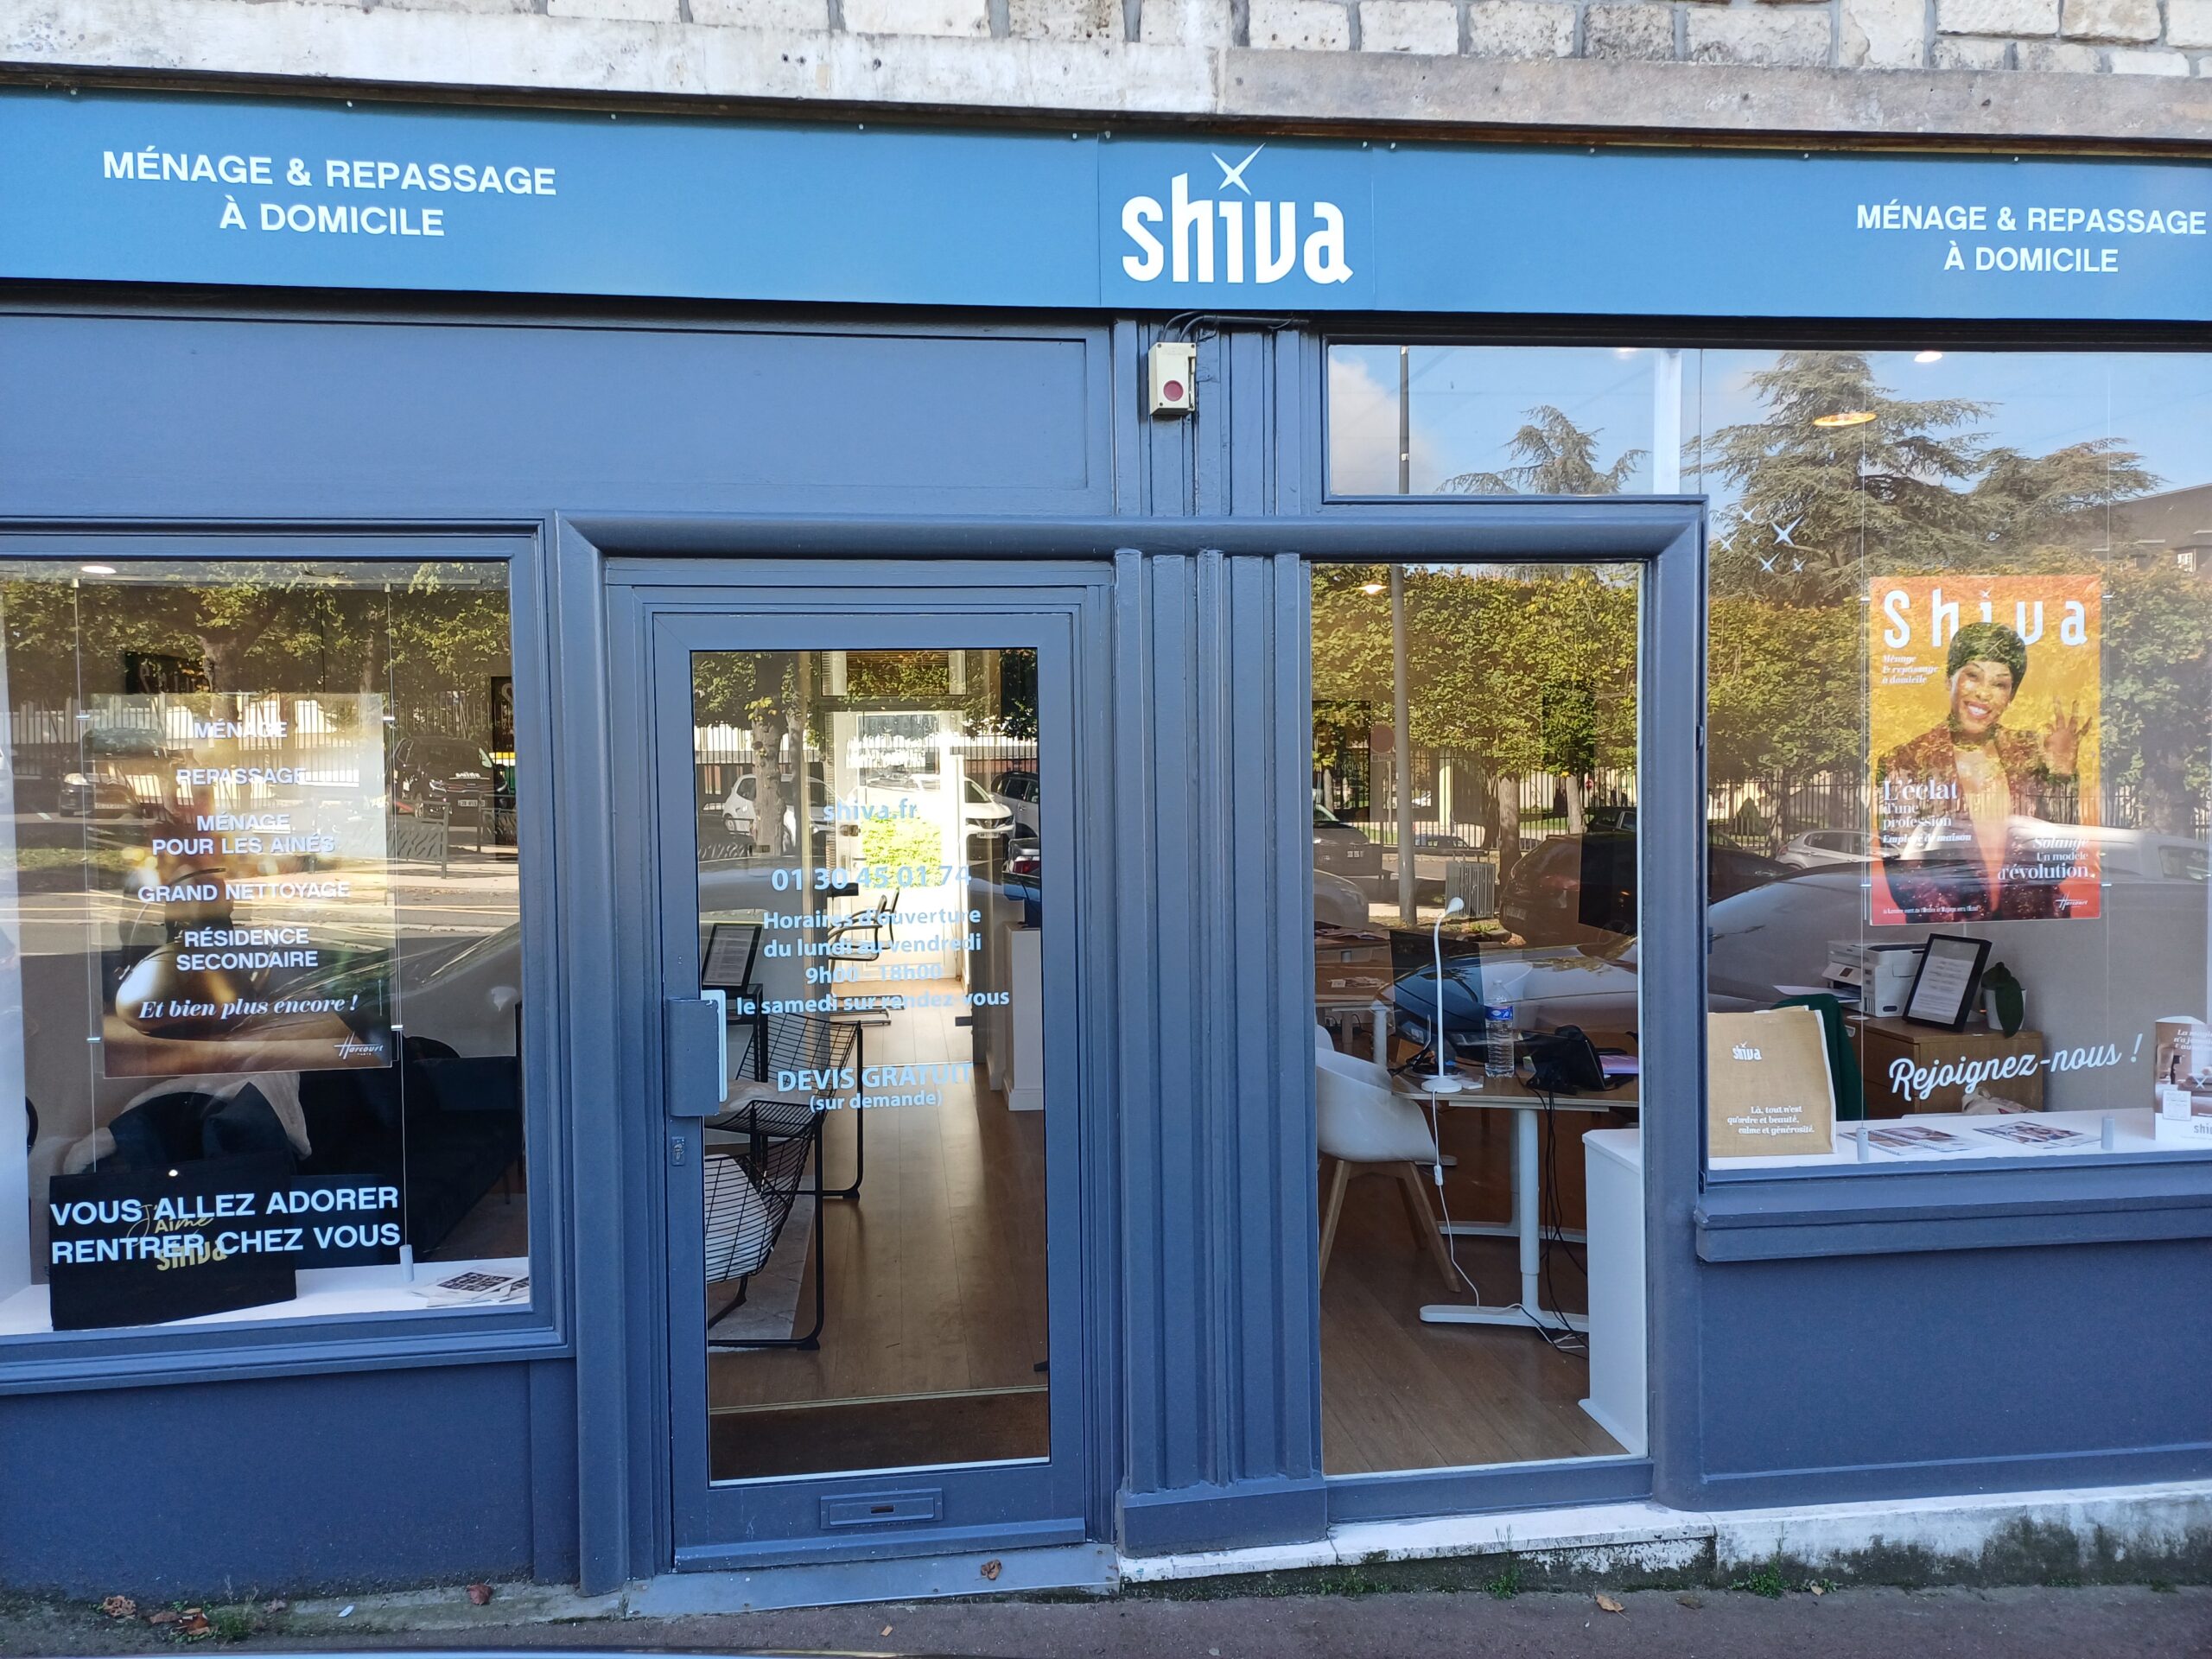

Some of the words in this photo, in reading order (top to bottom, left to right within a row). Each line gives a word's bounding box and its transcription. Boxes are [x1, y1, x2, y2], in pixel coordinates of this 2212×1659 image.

[103, 146, 272, 186] MÉNAGE
[286, 158, 313, 187] &
[326, 160, 557, 195] REPASSAGE
[219, 195, 246, 230] À
[261, 203, 444, 237] DOMICILE
[1122, 172, 1354, 284] shiva
[1857, 199, 1986, 231] MÉNAGE
[1997, 206, 2017, 232] &
[2027, 207, 2207, 235] REPASSAGE
[1944, 240, 1966, 270] À
[1975, 246, 2119, 273] DOMICILE
[1883, 588, 2088, 649] Shiva
[194, 718, 289, 740] MÉNAGE
[176, 766, 305, 785] REPASSAGE
[1884, 779, 1957, 800] L'éclat
[823, 798, 918, 823] shiva.fr
[1884, 802, 1919, 814] d'une
[197, 812, 290, 832] MÉNAGE
[1883, 816, 1951, 830] profession
[153, 837, 213, 855] POUR
[221, 836, 262, 855] LES
[270, 832, 335, 854] AINÉS
[1883, 834, 1923, 845] Emplyé
[2036, 852, 2050, 861] Un
[2053, 851, 2088, 861] modèle
[772, 868, 803, 891] 01
[814, 868, 849, 891] 30
[856, 867, 889, 889] 45
[896, 866, 928, 888] 01
[938, 865, 972, 887] 74
[137, 884, 218, 903] GRAND
[226, 881, 350, 900] NETTOYAGE
[763, 910, 854, 930] Horaires
[859, 906, 982, 927] d'ouverture
[184, 926, 309, 948] RÉSIDENCE
[764, 940, 791, 958] du
[797, 938, 852, 957] lundi
[856, 941, 885, 955] au
[888, 932, 982, 953] vendredi
[176, 950, 318, 972] SECONDAIRE
[805, 965, 859, 985] 9h00
[878, 962, 943, 982] 18h00
[138, 1001, 163, 1019] Et
[168, 999, 215, 1018] bien
[220, 997, 268, 1020] plus
[272, 996, 346, 1014] encore
[349, 995, 359, 1011] !
[736, 998, 756, 1015] le
[761, 994, 839, 1014] samedi
[843, 996, 874, 1012] sur
[877, 988, 1010, 1010] rendez-vous
[334, 1030, 384, 1060] Harcourt
[1732, 1045, 1763, 1061] shiva
[778, 1066, 855, 1092] DEVIS
[861, 1062, 973, 1090] GRATUIT
[1889, 1040, 2122, 1103] Rejoignez-nous
[2130, 1033, 2144, 1063] !
[809, 1095, 845, 1114] (sur
[849, 1090, 944, 1110] demande)
[1783, 1105, 1803, 1114] n'est
[1738, 1126, 1761, 1135] calme
[50, 1198, 143, 1227] VOUS
[154, 1192, 256, 1221] ALLEZ
[266, 1185, 398, 1214] ADORER
[52, 1233, 205, 1264] RENTRER
[217, 1228, 303, 1253] CHEZ
[314, 1223, 401, 1248] VOUS
